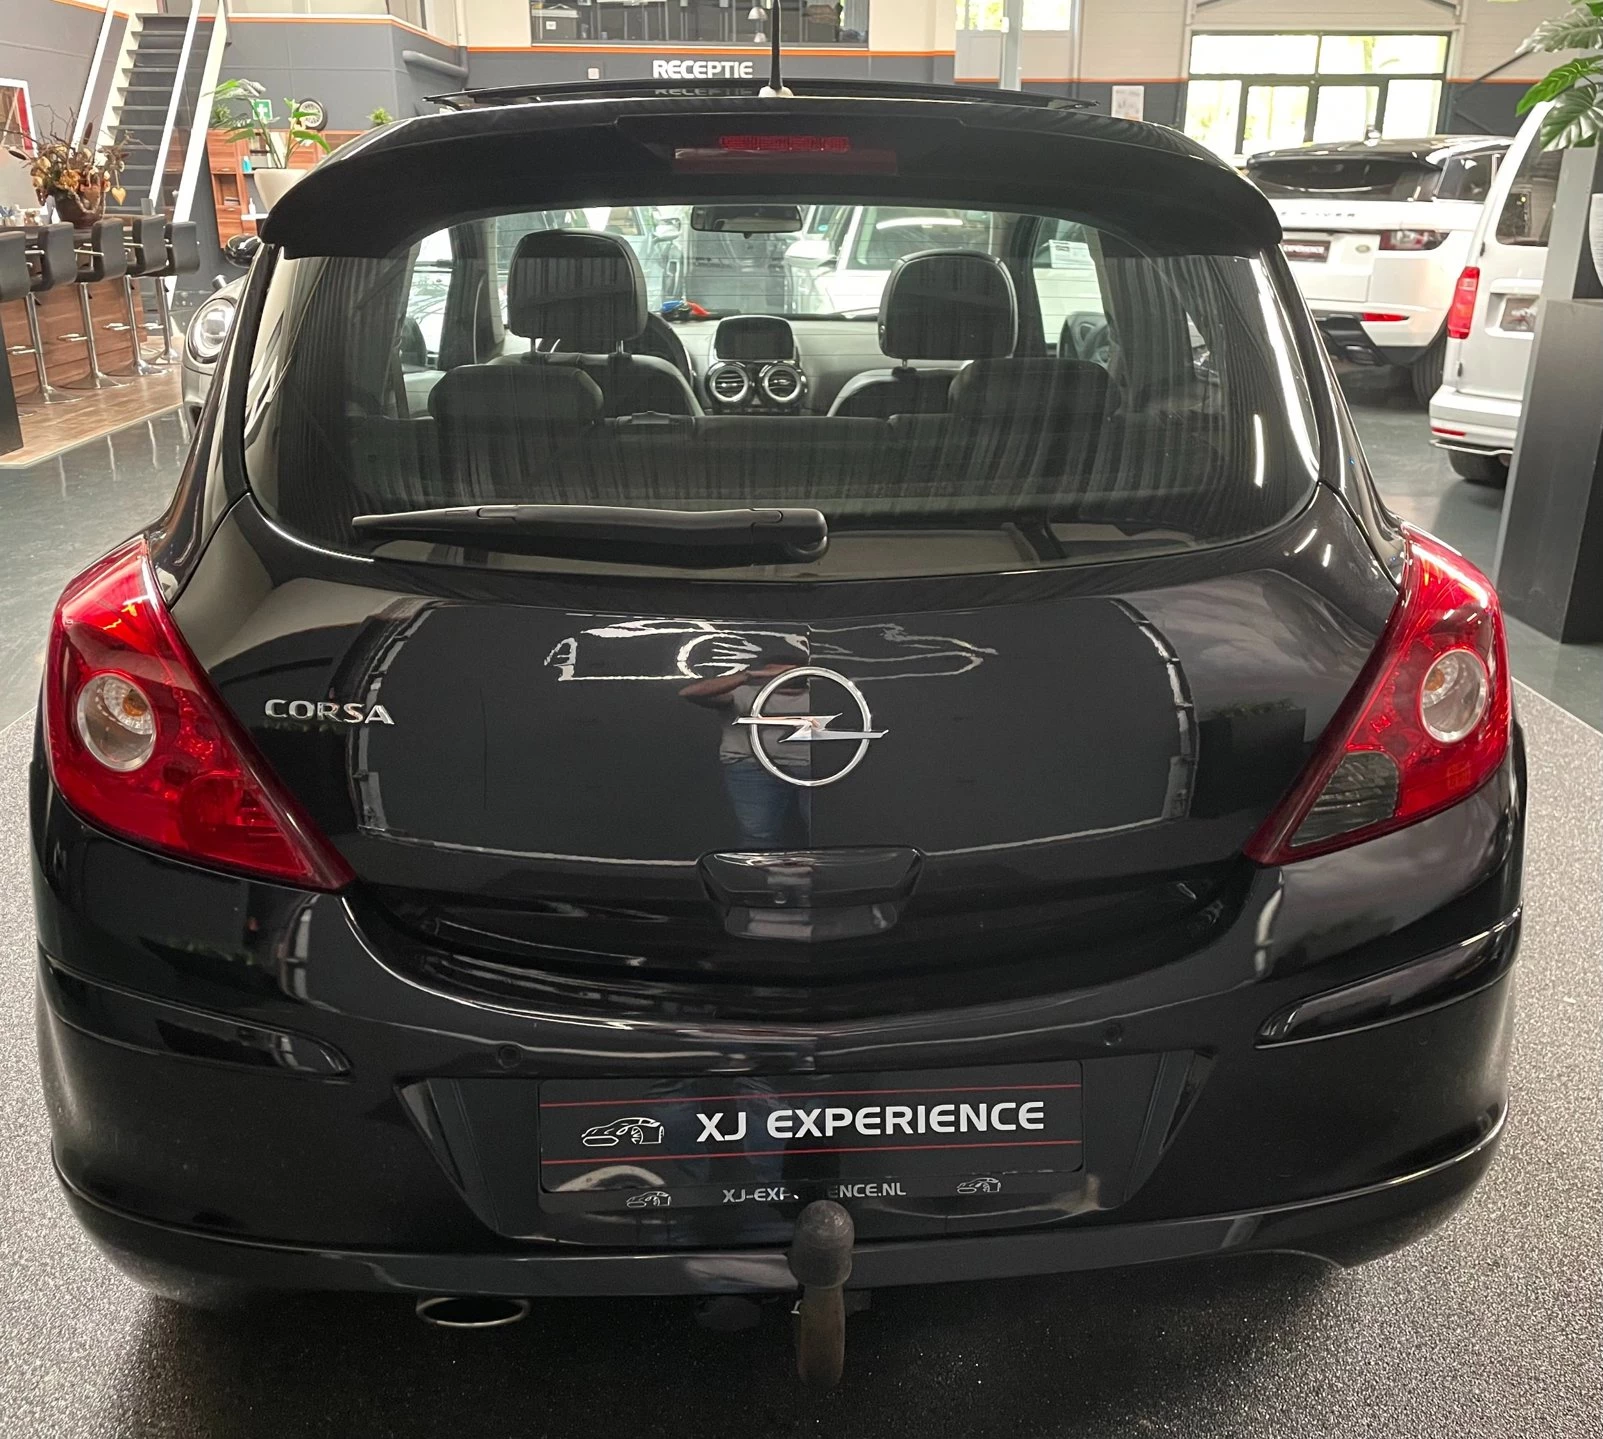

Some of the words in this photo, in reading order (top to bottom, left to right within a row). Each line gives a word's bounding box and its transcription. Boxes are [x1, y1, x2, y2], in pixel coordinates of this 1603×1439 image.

[652, 59, 754, 79] RECEPTIE
[264, 698, 396, 725] CORSA
[696, 1111, 748, 1143] XJ
[766, 1100, 1045, 1140] EXPERIENCE
